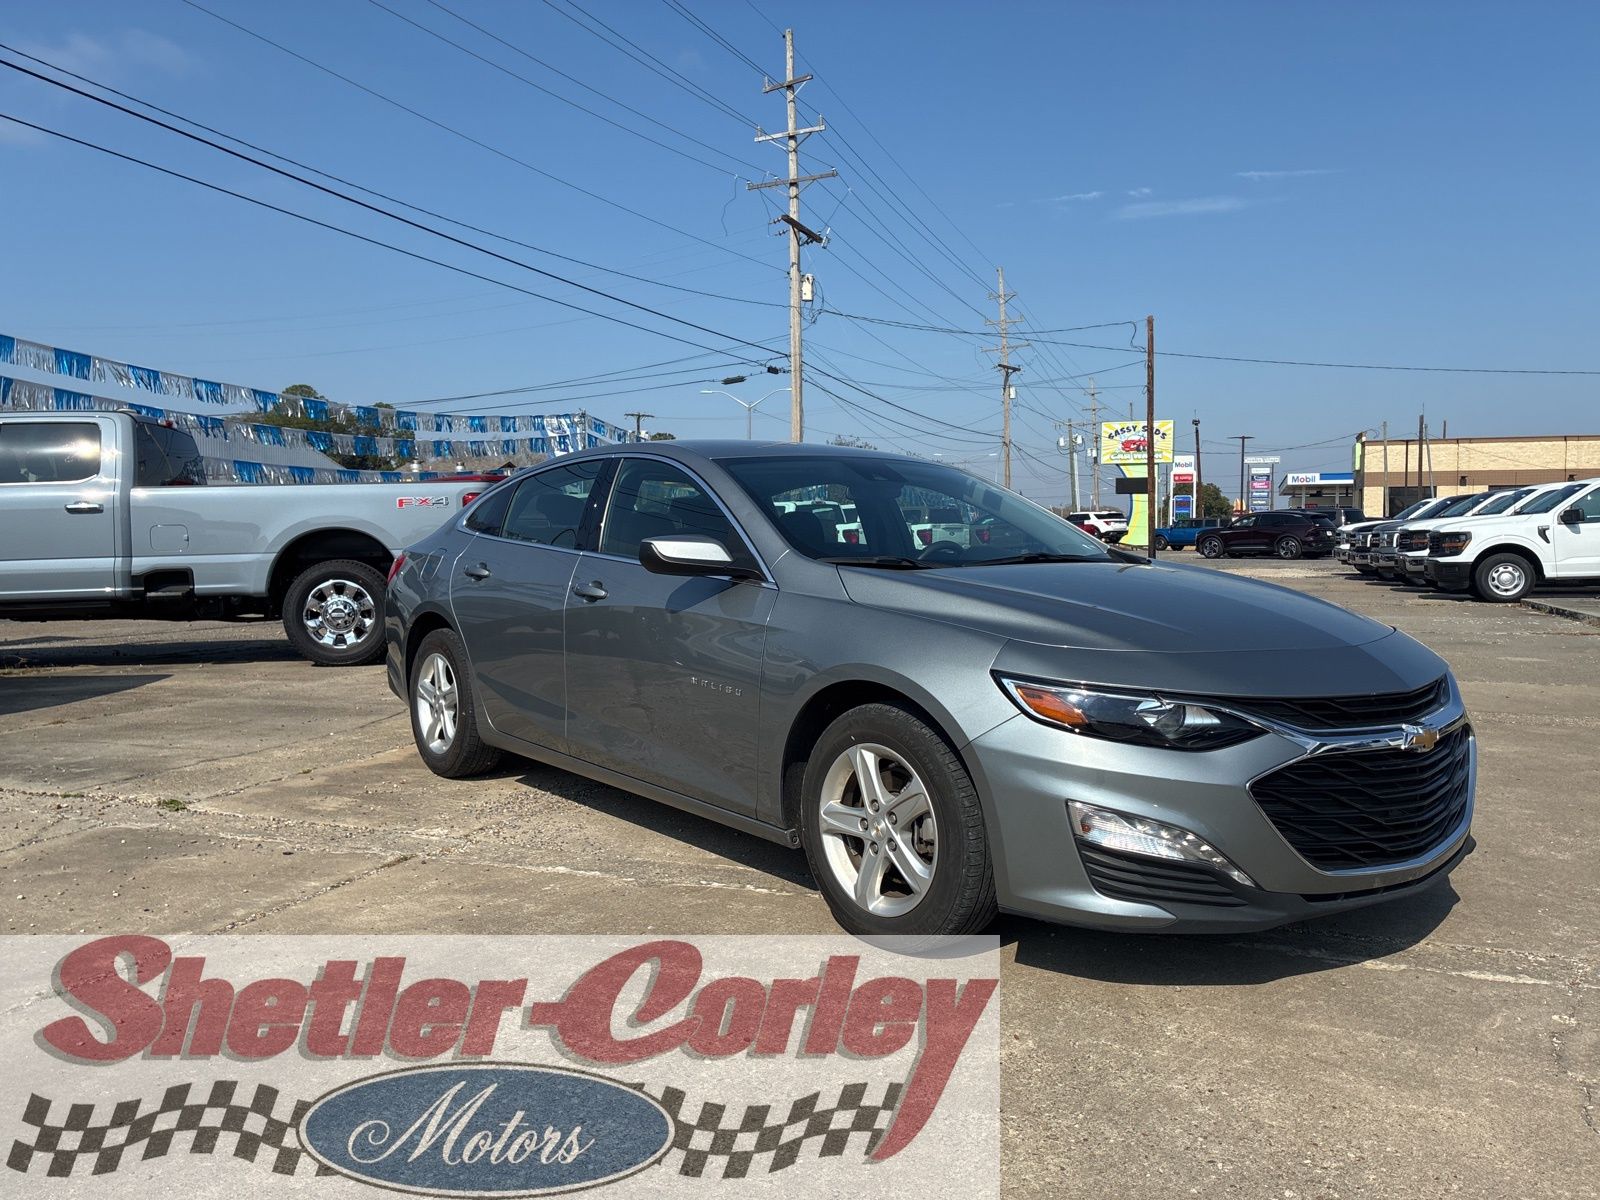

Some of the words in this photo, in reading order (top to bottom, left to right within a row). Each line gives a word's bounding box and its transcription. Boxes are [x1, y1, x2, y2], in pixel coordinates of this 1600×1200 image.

[1108, 425, 1138, 440] SASSY
[1142, 425, 1167, 440] SDS
[1174, 461, 1193, 469] Mobil
[1291, 475, 1316, 484] Mobil
[396, 496, 449, 509] FX4
